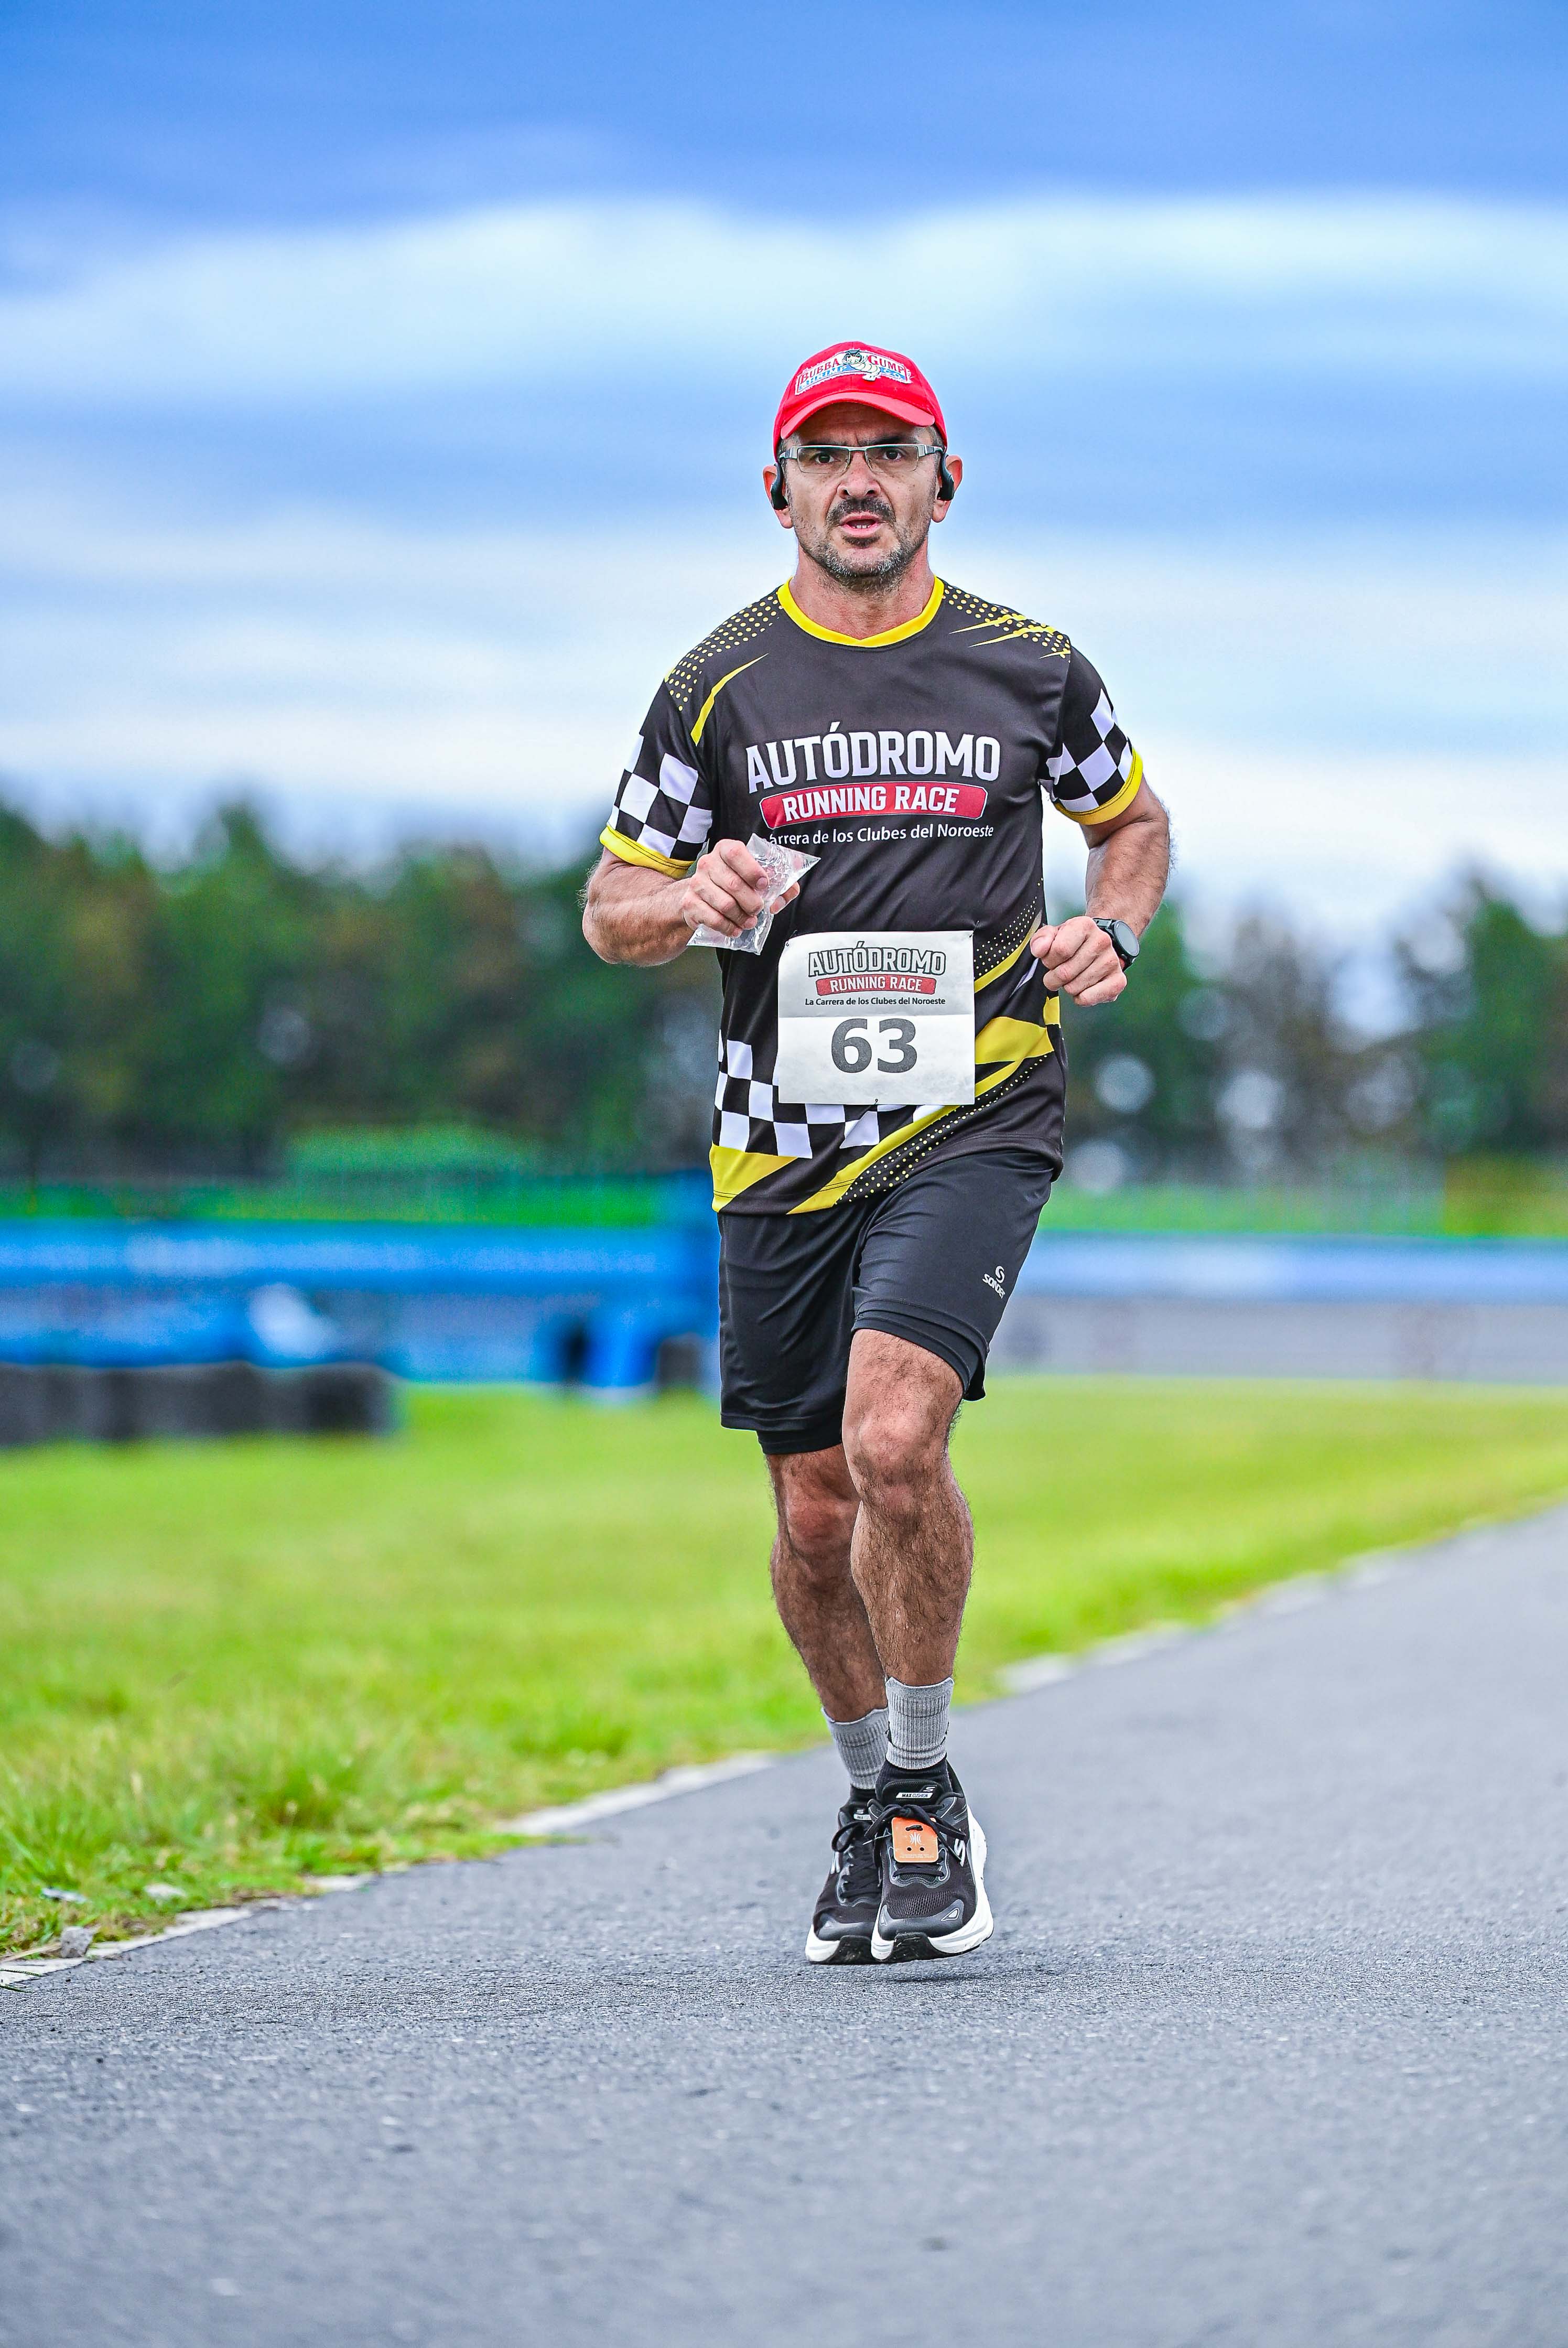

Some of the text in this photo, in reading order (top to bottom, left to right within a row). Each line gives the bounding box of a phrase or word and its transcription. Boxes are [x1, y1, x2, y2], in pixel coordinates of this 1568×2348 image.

[801, 355, 905, 384] BUBBA GUMP
[745, 721, 1001, 794] AUTÓDROMO
[782, 785, 960, 822] RUNNING RACE
[770, 823, 994, 845] arrera de los Clubes del Noroeste
[808, 941, 946, 977] AUTÓDROMO
[829, 976, 923, 993] RUNNING RACE
[831, 1018, 917, 1073] 63
